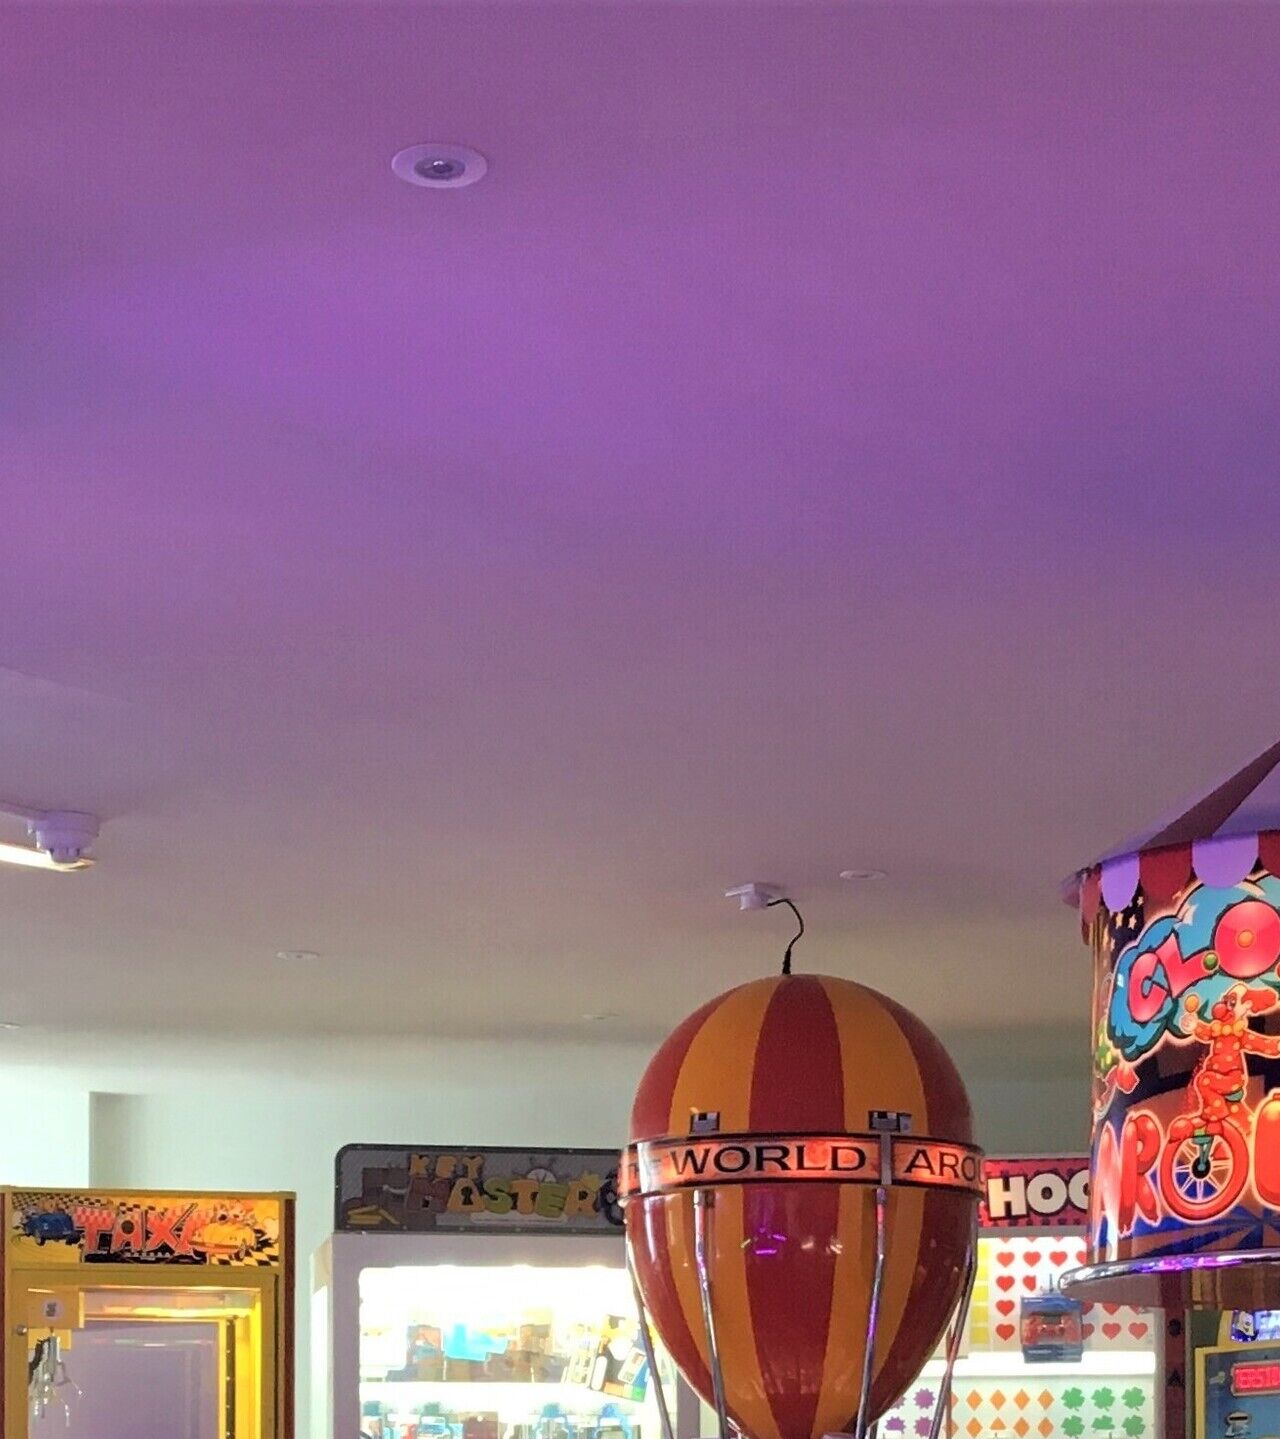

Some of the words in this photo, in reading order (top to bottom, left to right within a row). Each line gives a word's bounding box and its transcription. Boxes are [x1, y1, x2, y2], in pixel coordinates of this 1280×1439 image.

[670, 1145, 867, 1174] WORLD
[904, 1150, 989, 1184] ARO
[406, 1177, 599, 1218] MASTER
[75, 1204, 198, 1256] TAXI
